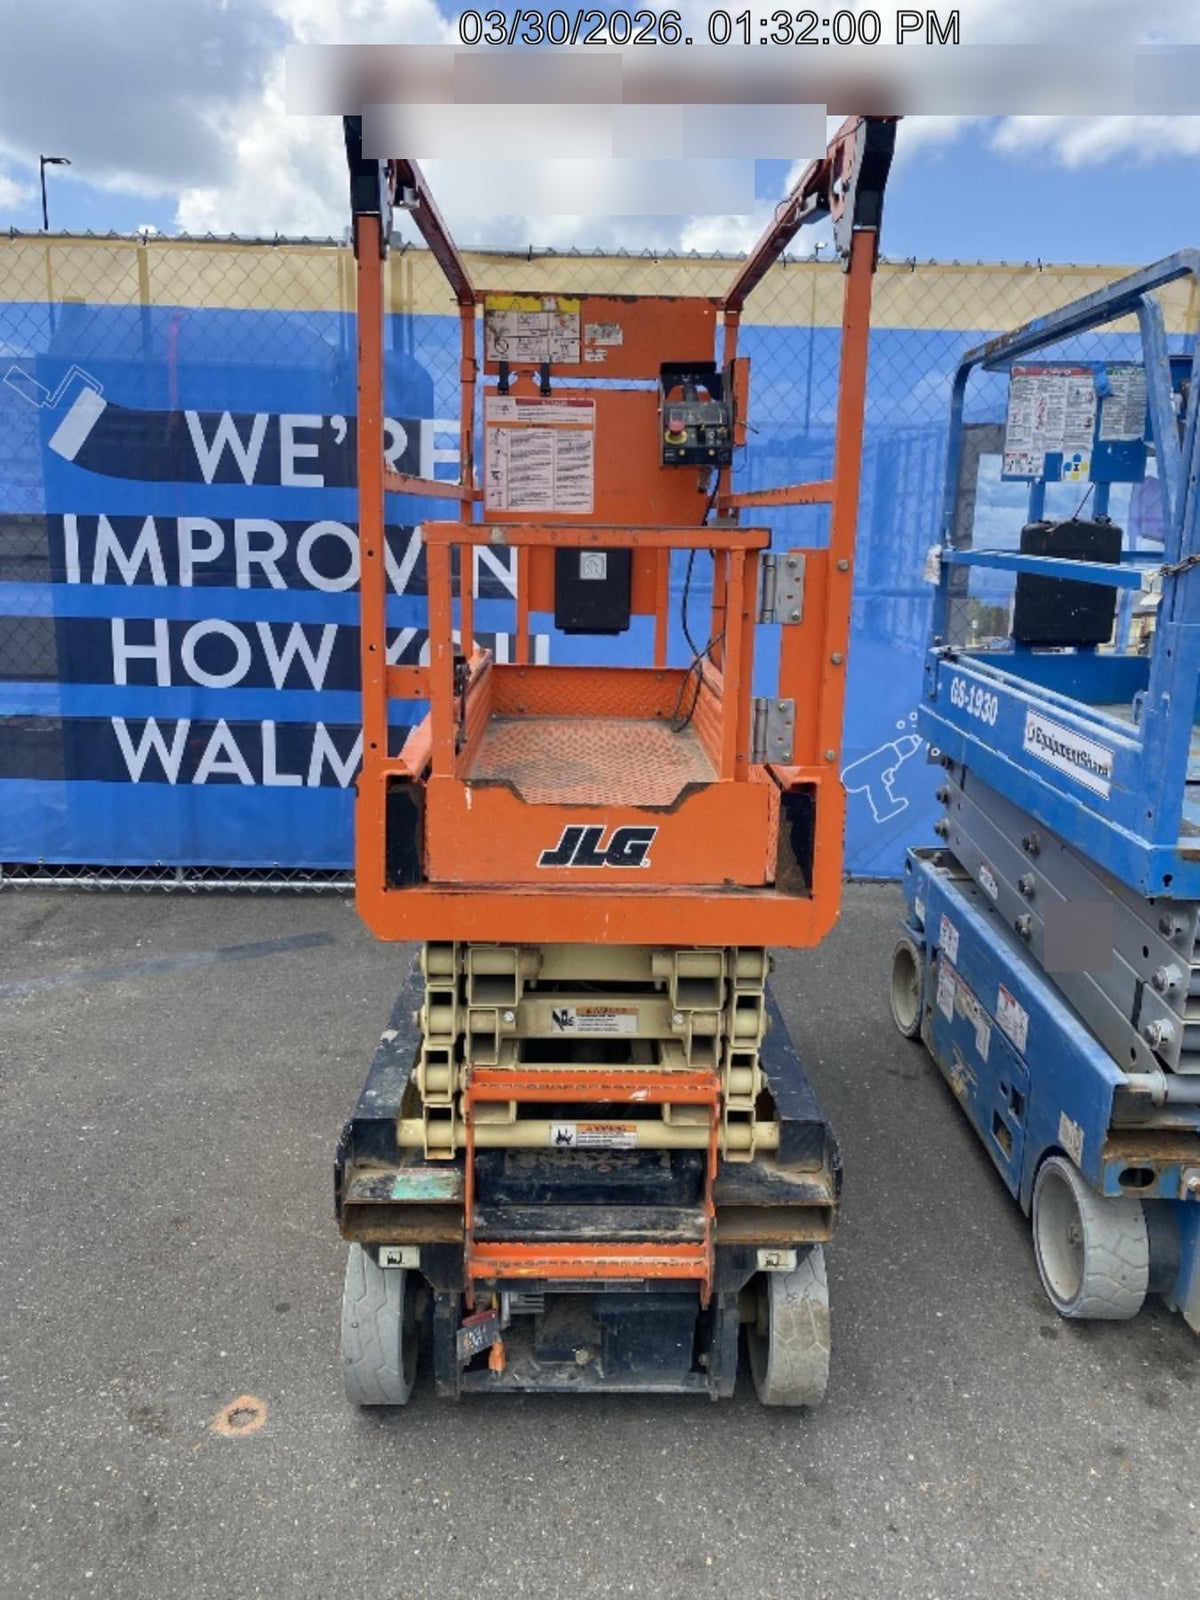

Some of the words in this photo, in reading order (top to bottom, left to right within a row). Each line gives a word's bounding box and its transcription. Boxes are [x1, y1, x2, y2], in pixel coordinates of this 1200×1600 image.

[111, 617, 339, 691] HOW
[951, 676, 998, 727] GS-1930
[536, 824, 659, 868] JLG
